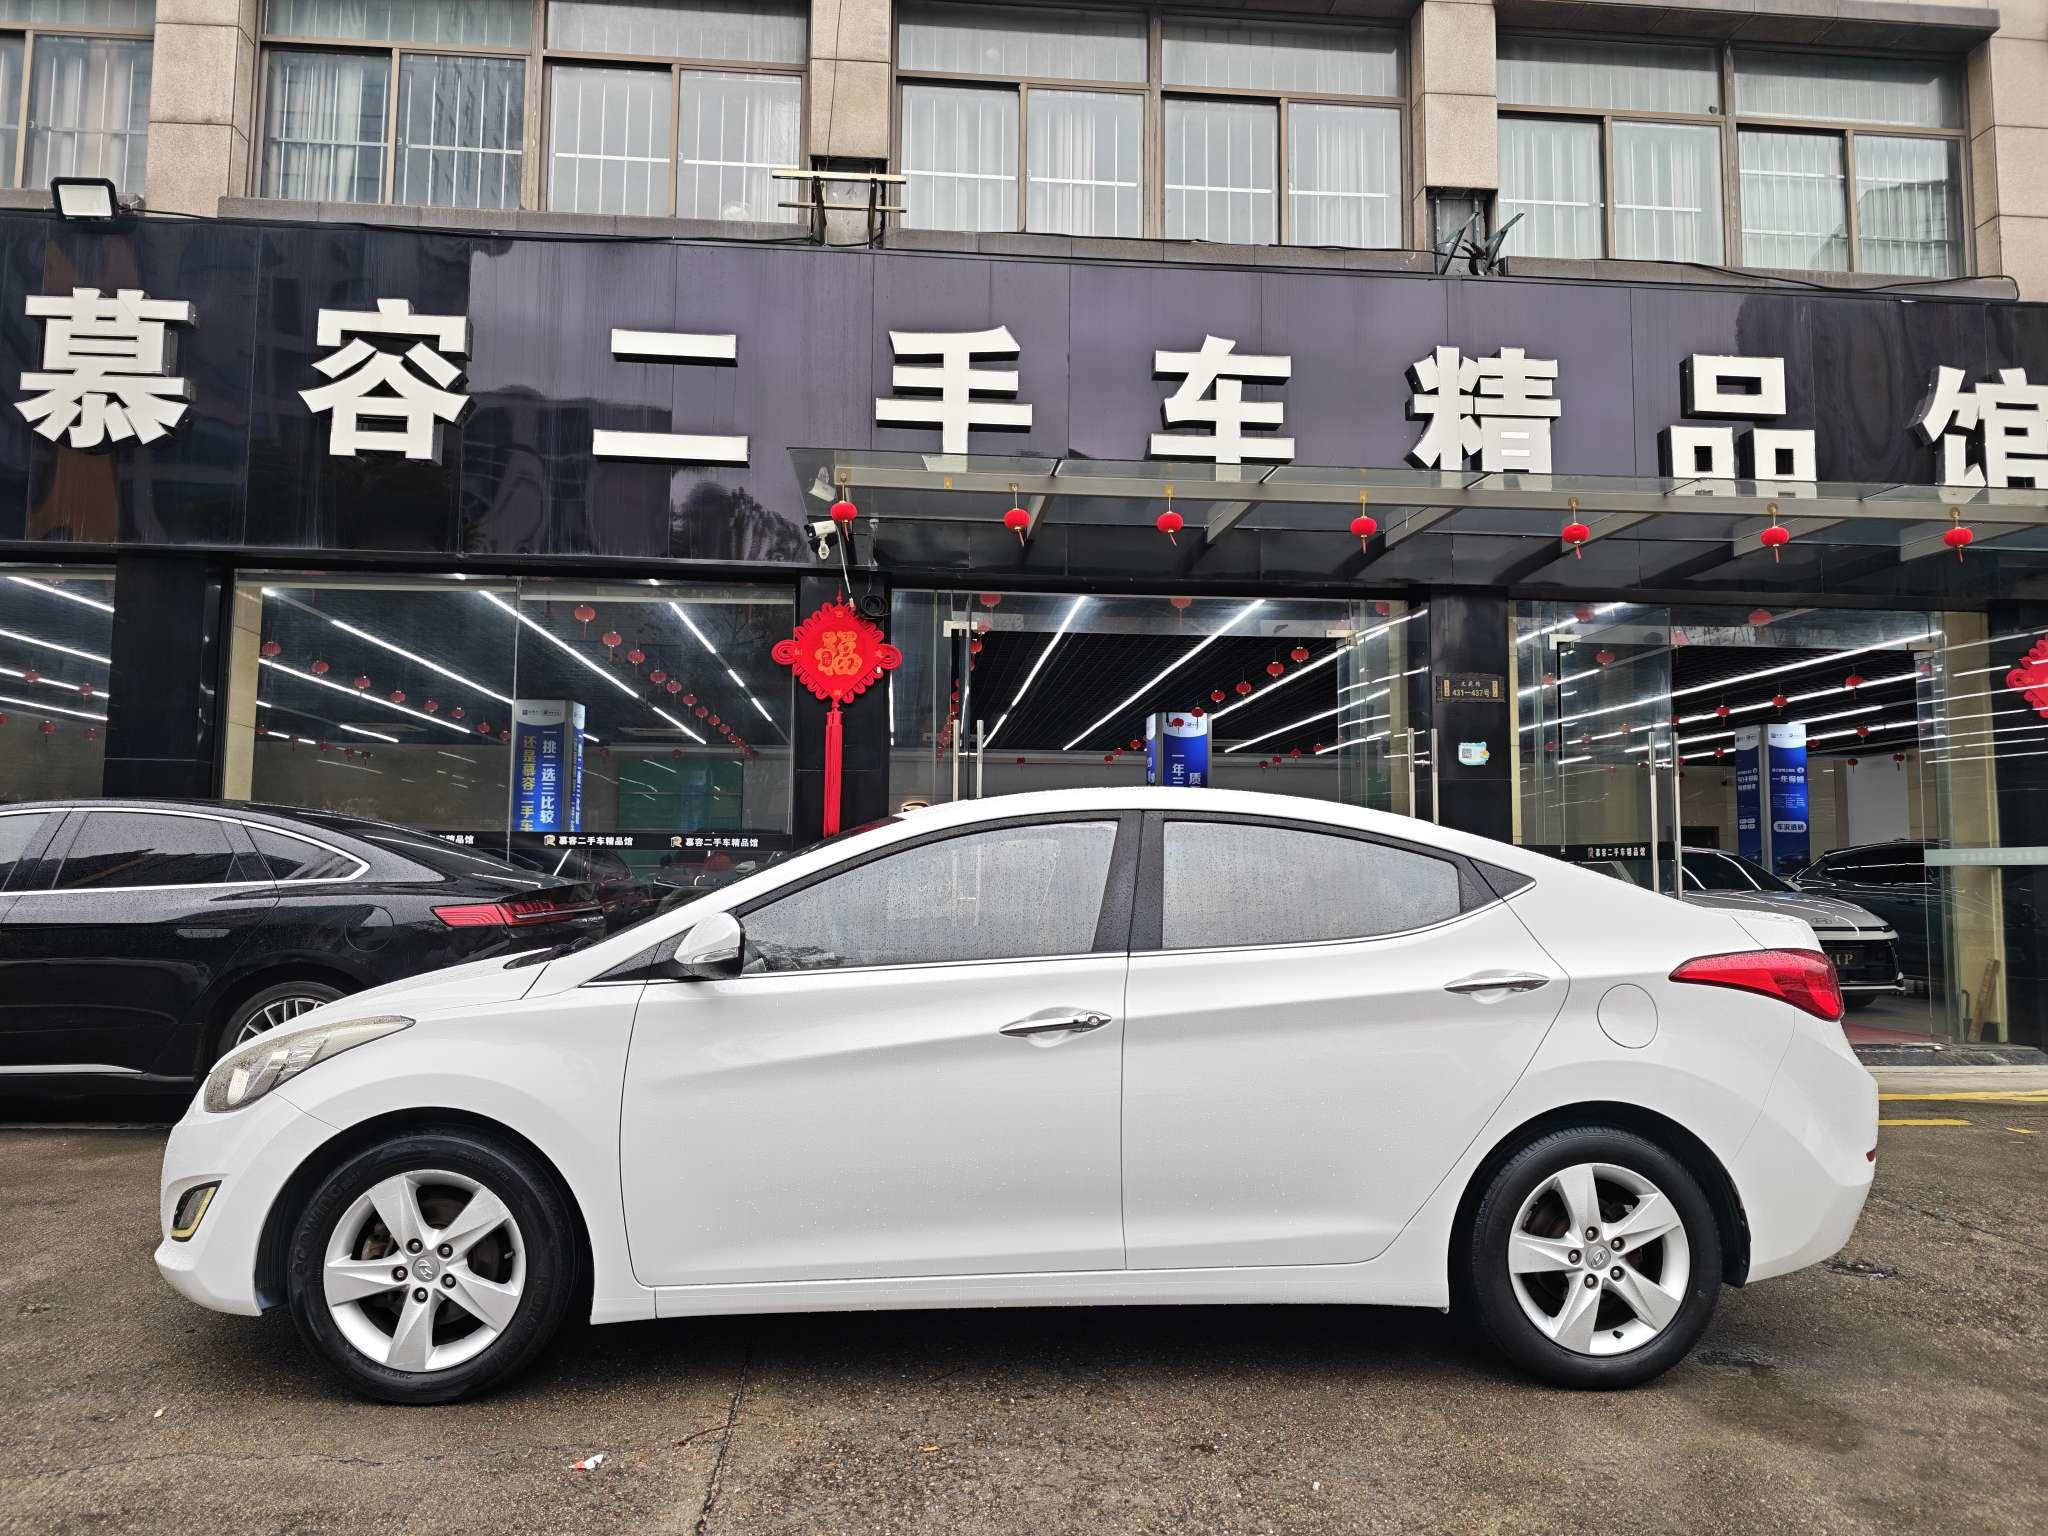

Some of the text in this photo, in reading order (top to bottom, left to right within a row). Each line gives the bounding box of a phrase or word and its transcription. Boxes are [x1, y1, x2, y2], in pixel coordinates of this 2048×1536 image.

[14, 286, 2048, 502] 慕容二手车精品馆
[439, 834, 474, 845] 精品馆
[557, 835, 634, 846] 慕容二手车精品馆
[685, 837, 759, 848] 慕容二手车精品馆
